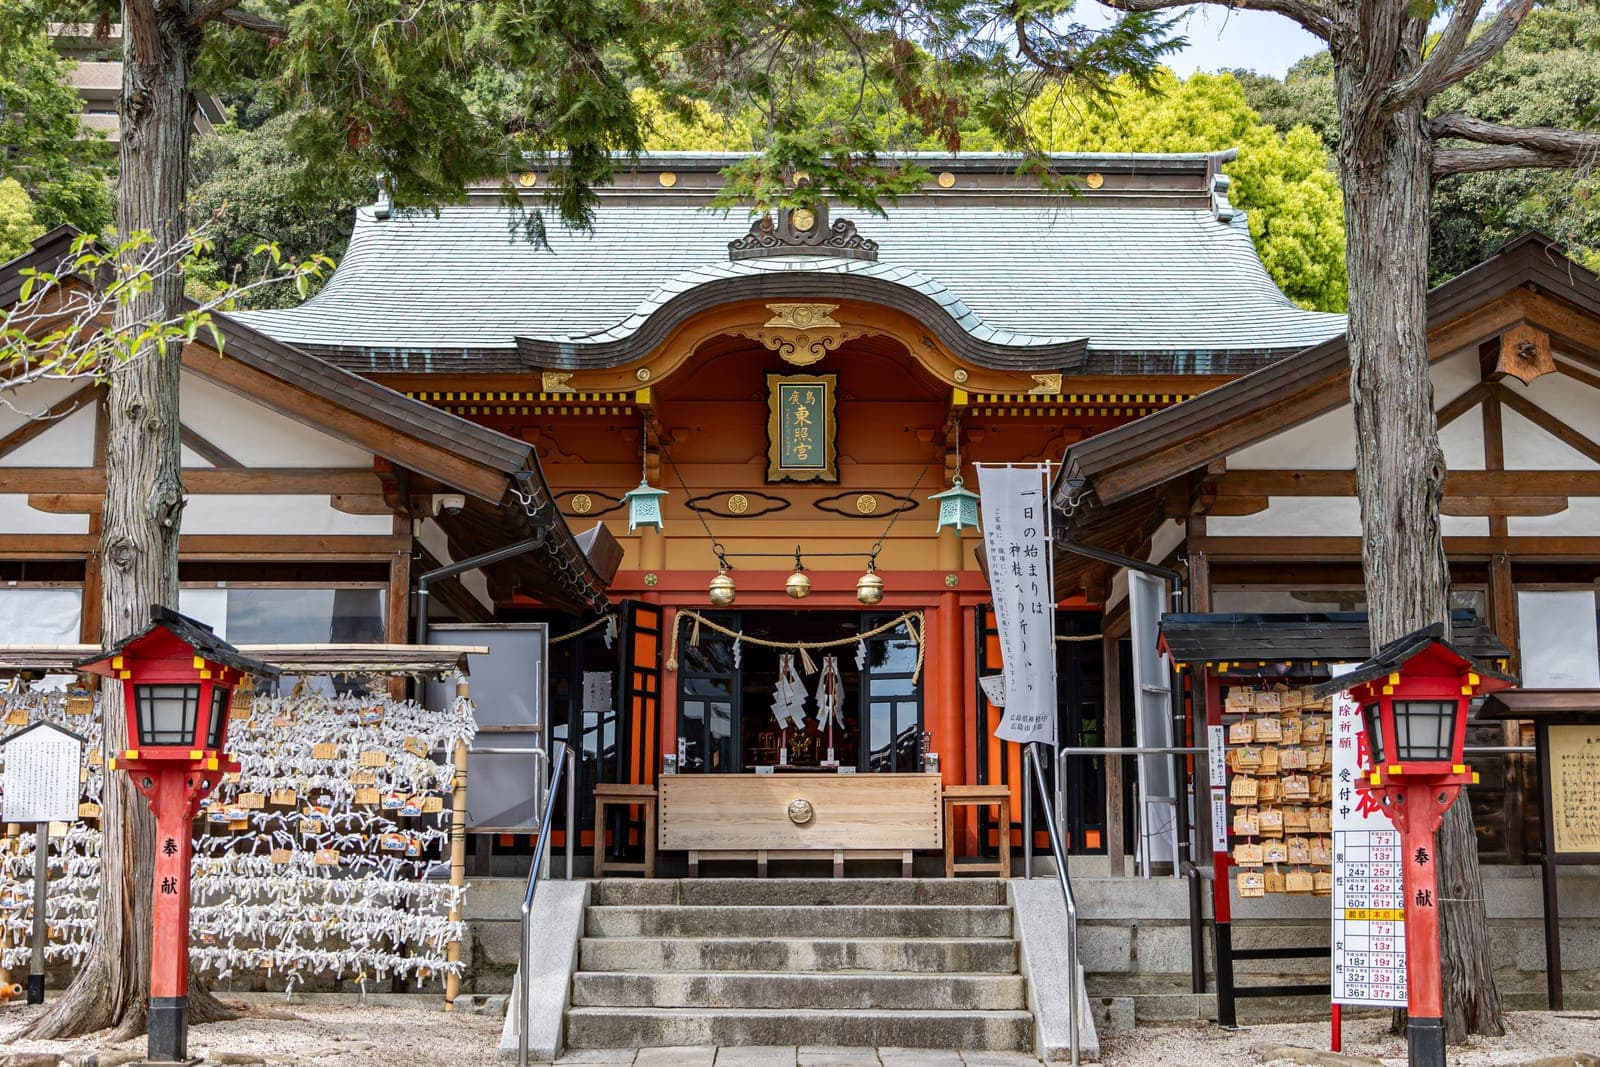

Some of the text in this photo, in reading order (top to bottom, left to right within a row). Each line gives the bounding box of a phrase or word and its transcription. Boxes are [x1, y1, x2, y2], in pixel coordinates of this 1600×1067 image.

[793, 404, 813, 461] 東照宮
[1020, 491, 1043, 614] 一日の始まりは
[1338, 768, 1352, 821] 受付中
[161, 838, 178, 895] 奉献
[1336, 853, 1344, 886] 男性
[1414, 847, 1433, 907] 奉献
[1336, 941, 1344, 974] 女性
